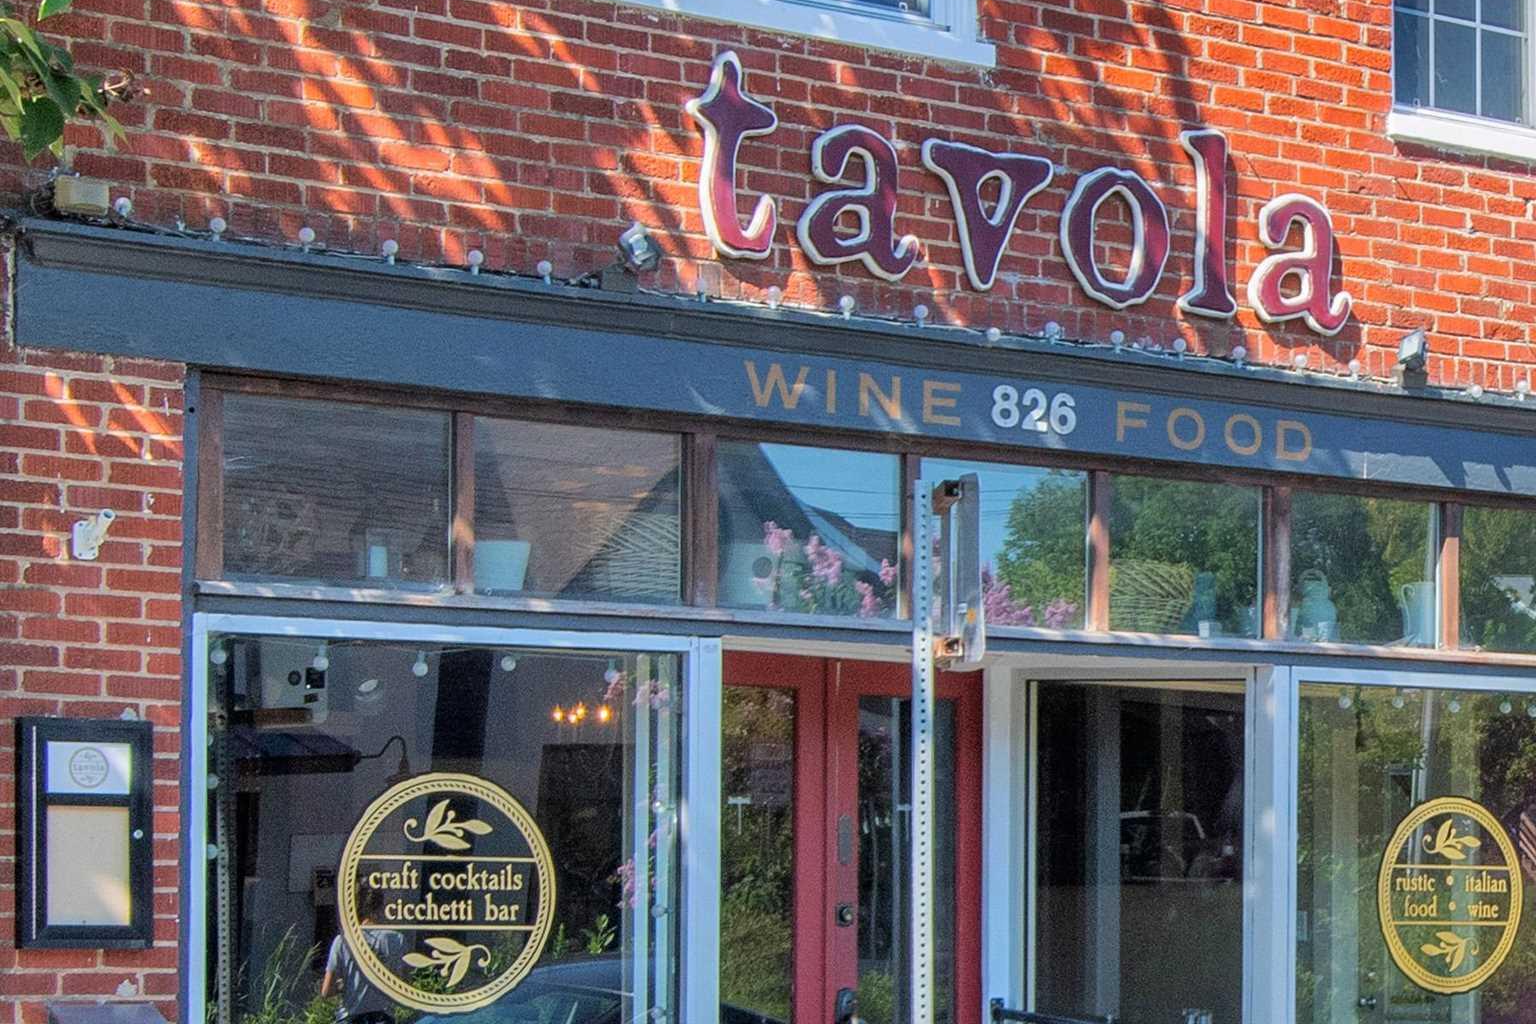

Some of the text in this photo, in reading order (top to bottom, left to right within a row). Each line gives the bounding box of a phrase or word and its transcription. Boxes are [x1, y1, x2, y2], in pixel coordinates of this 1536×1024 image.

[684, 49, 1353, 336] tavola
[744, 361, 1313, 462] WINE 826 FOOD
[368, 861, 523, 891] craft cocktails
[1395, 870, 1508, 893] rustic italian
[384, 892, 520, 921] cicchetti bar
[1404, 894, 1499, 918] food wine
